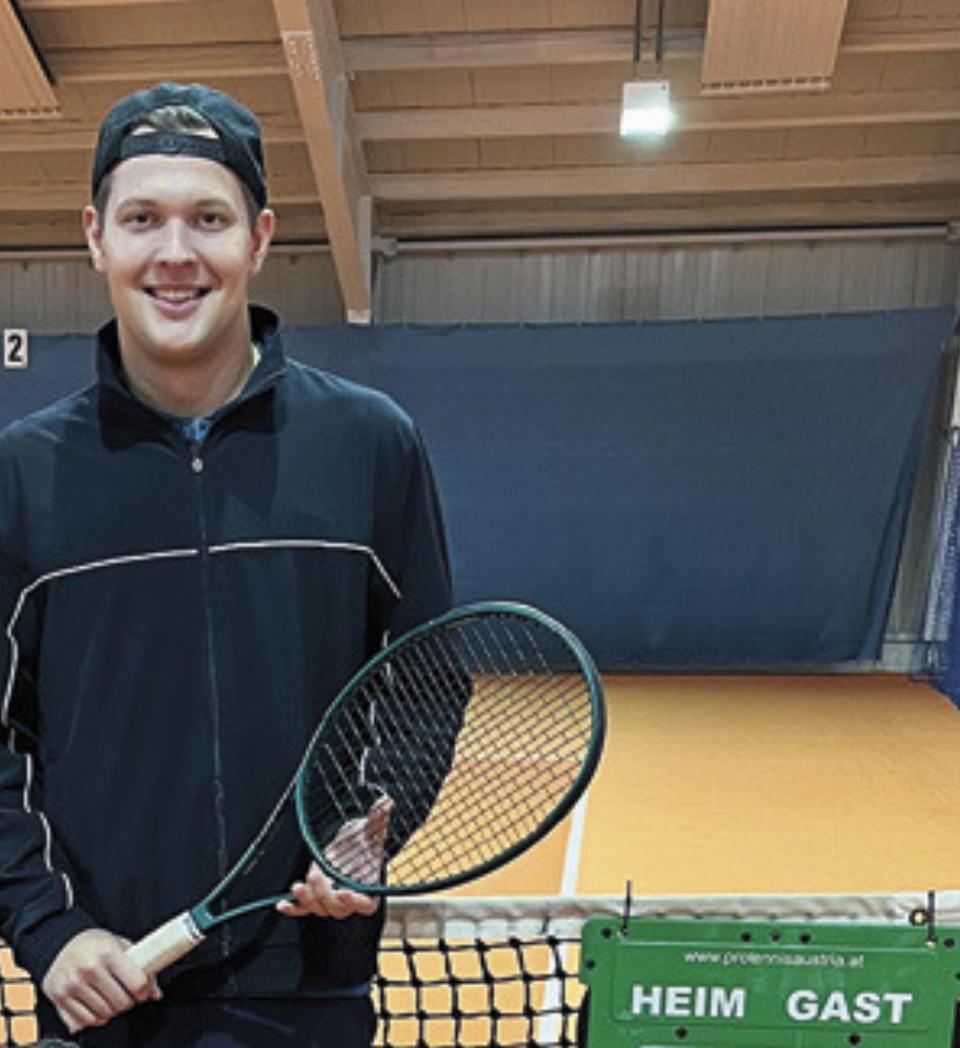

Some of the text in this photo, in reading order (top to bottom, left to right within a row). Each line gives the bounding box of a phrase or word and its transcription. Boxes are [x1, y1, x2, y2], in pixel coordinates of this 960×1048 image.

[7, 333, 23, 362] 2
[631, 985, 913, 1024] HEIM GAST
